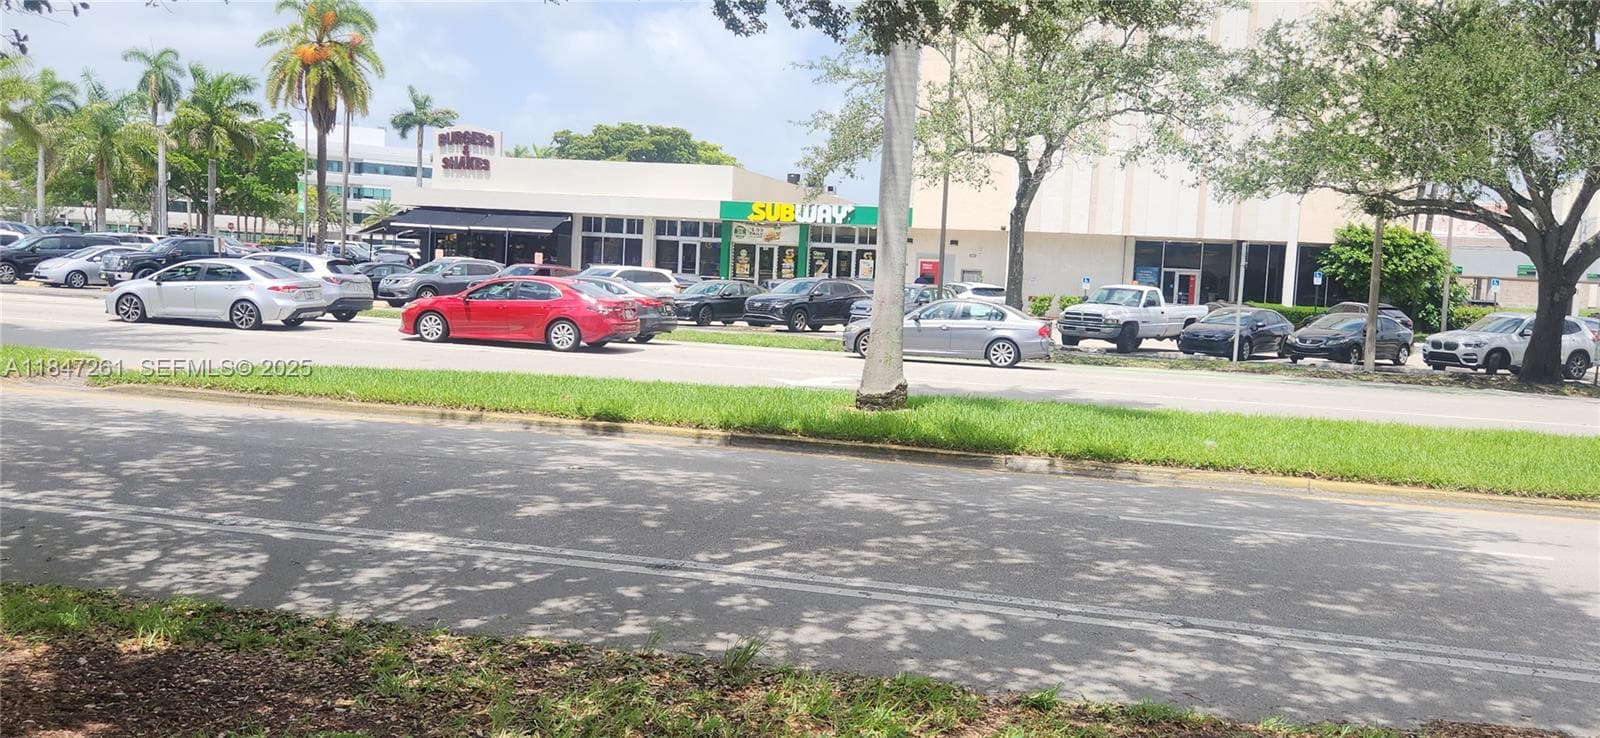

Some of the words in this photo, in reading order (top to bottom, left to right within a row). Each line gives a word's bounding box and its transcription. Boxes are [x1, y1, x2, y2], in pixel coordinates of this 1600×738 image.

[438, 131, 495, 147] BURGERS
[462, 145, 470, 157] &
[442, 156, 490, 171] SHAKES
[747, 202, 855, 224] SUBWAY
